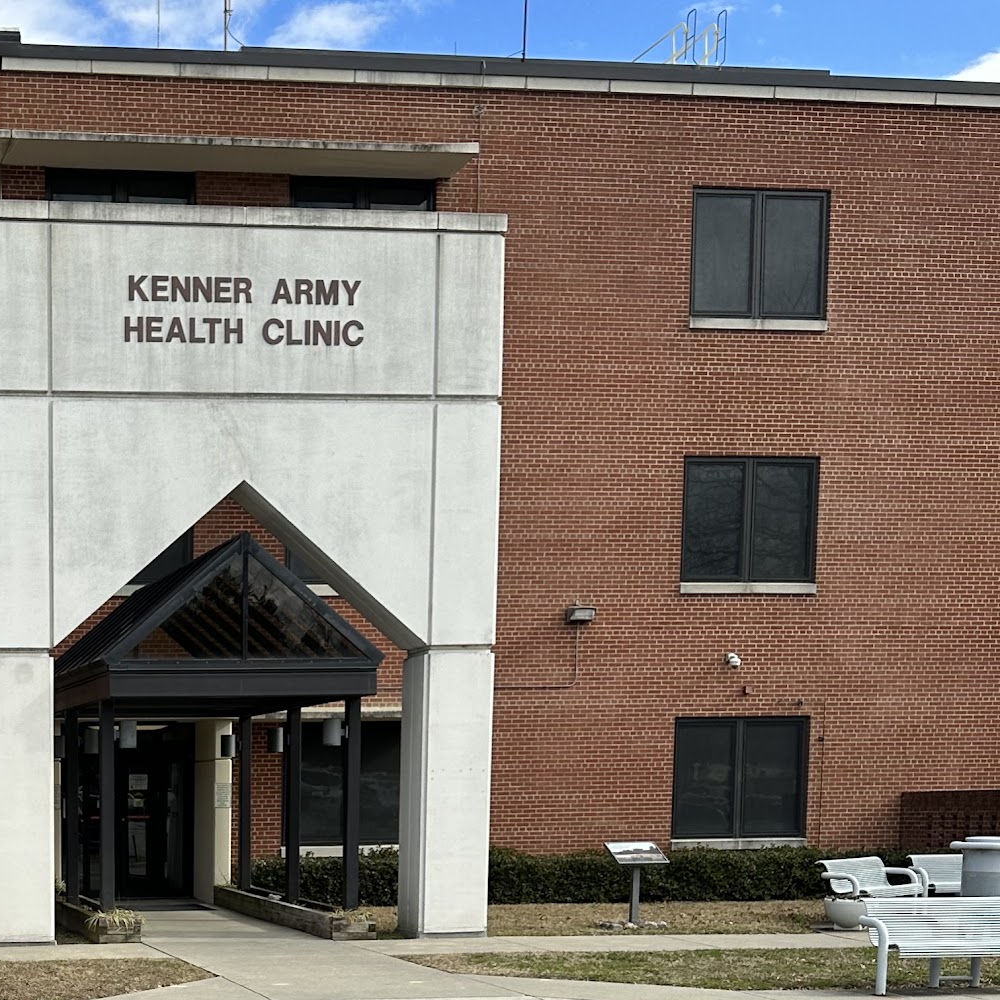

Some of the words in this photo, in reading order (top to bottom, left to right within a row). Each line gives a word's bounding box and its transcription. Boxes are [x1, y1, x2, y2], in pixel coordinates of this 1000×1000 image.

[128, 275, 253, 304] KENNER
[271, 278, 362, 306] ARMY
[124, 316, 244, 344] HEALTH
[262, 318, 364, 347] CLINIC
